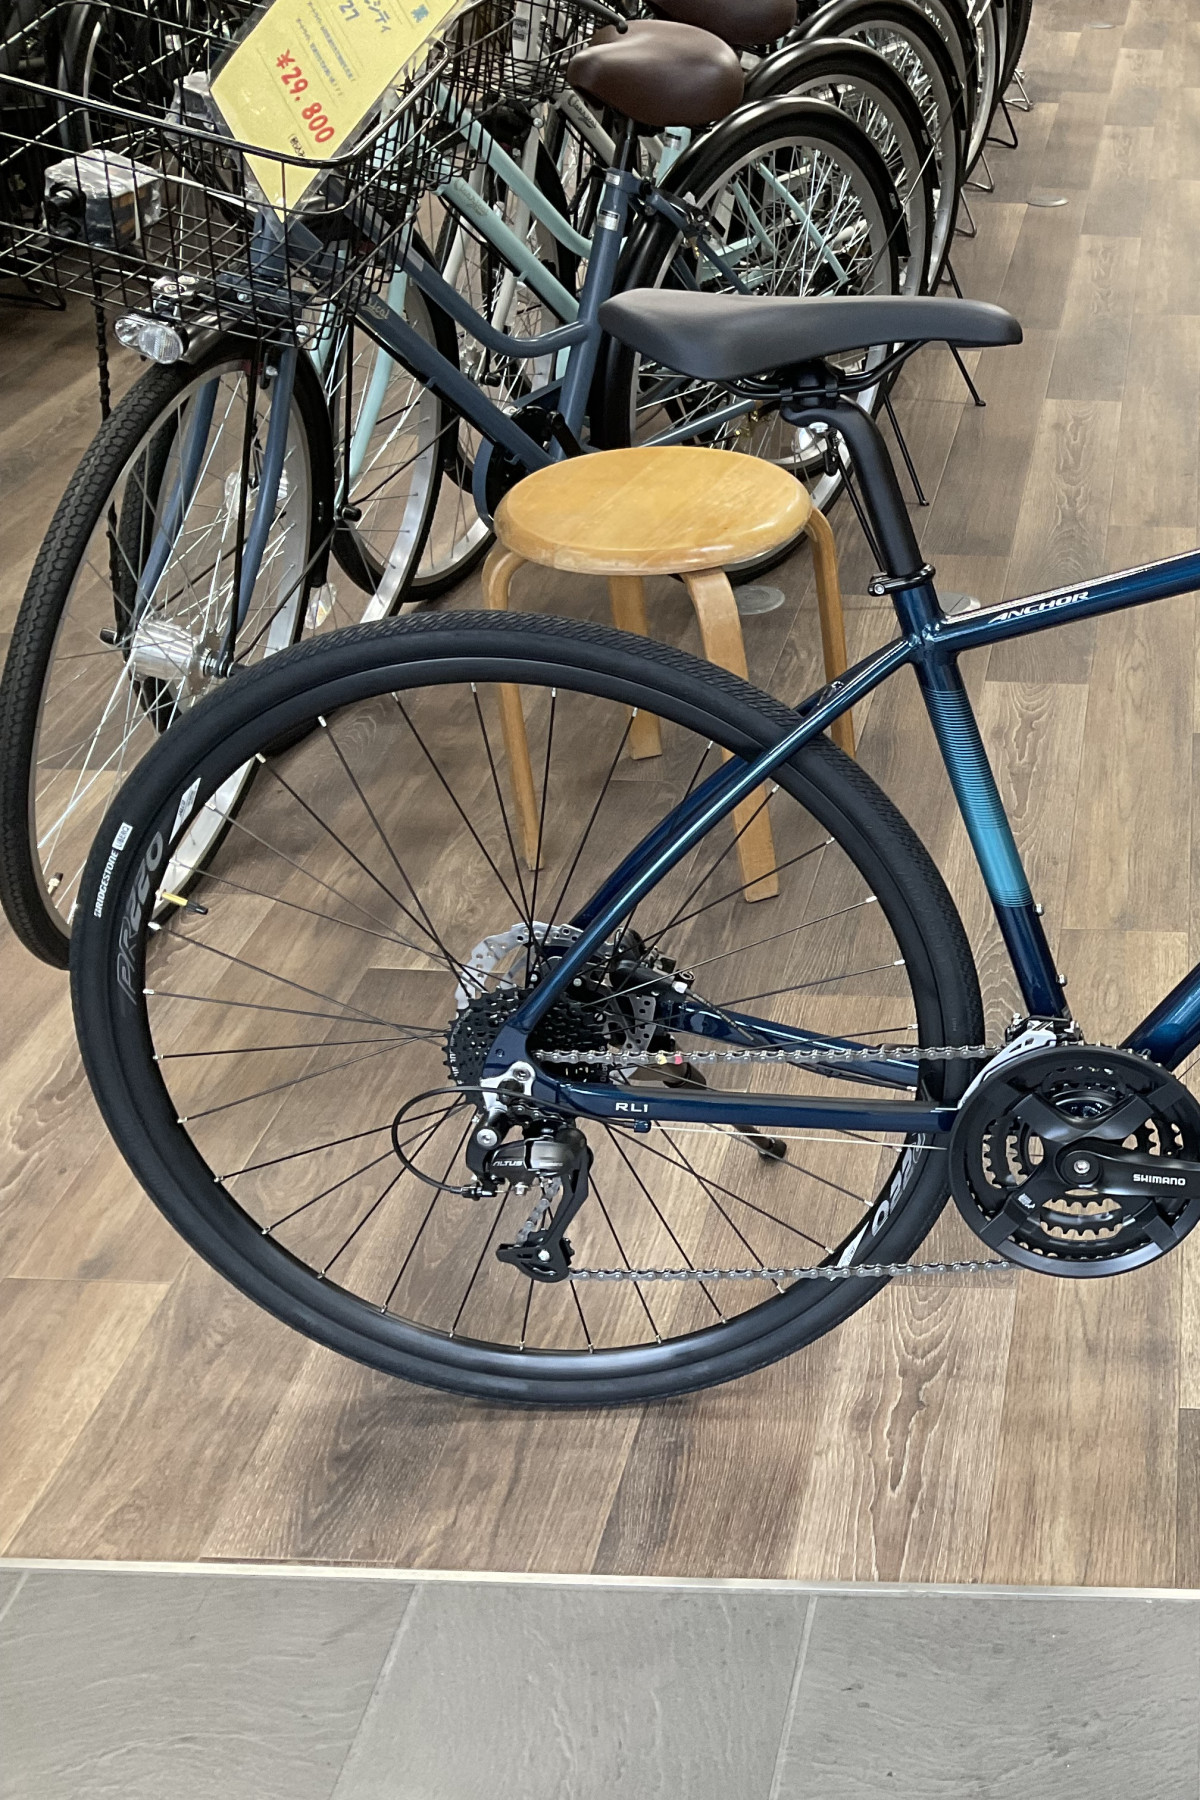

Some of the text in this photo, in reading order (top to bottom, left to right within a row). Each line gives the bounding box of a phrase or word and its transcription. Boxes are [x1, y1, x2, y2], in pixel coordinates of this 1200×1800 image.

[988, 591, 1089, 624] ANCHOR
[93, 849, 119, 918] BRIDGESTONE
[1132, 1173, 1186, 1186] SHIMANO
